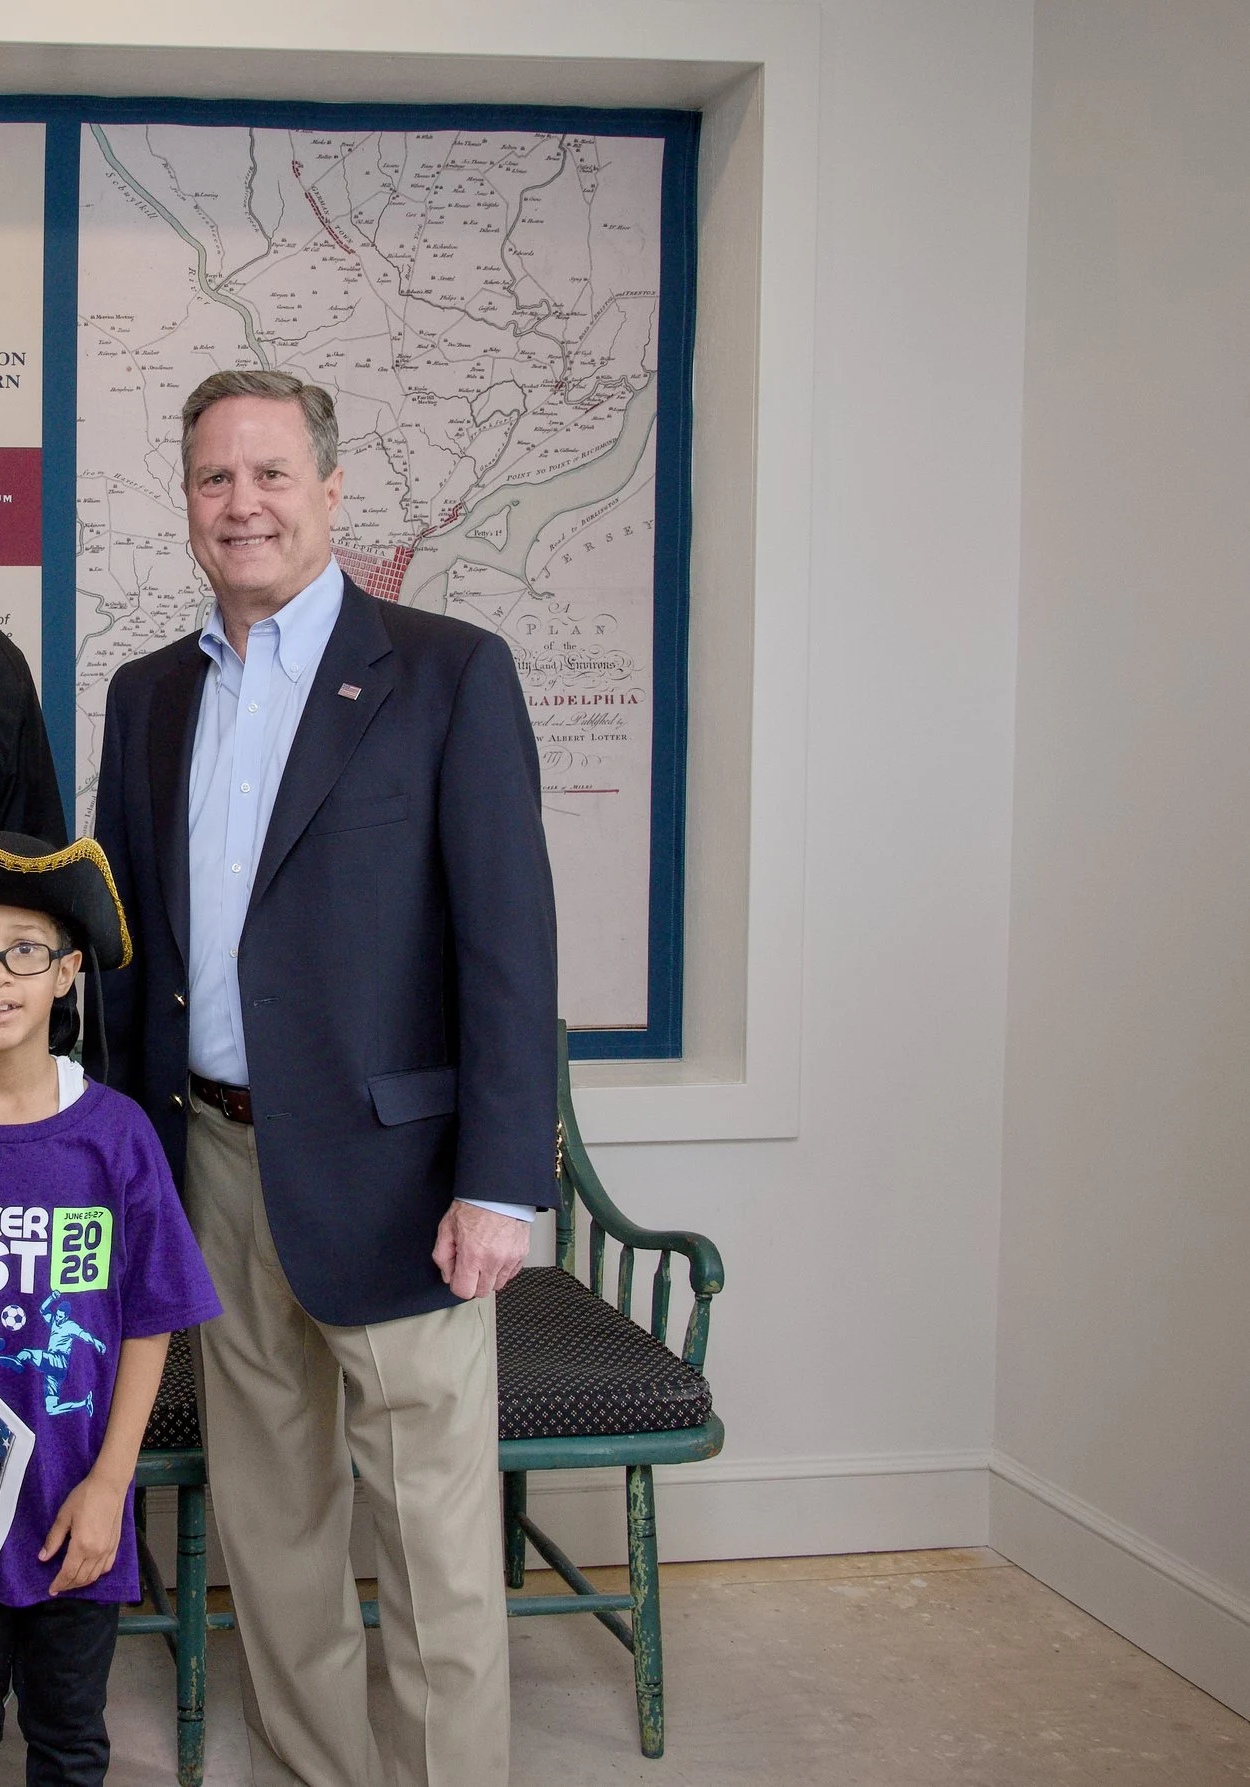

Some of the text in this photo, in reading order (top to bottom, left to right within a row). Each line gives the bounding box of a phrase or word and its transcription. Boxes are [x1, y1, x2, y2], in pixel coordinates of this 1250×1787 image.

[506, 471, 531, 481] POINT
[525, 623, 606, 636] PLAN
[543, 641, 577, 650] of the
[539, 661, 557, 670] and
[529, 694, 638, 706] LADELPHIA
[549, 733, 586, 742] ALBERT
[64, 1212, 83, 1220] JUNE
[62, 1220, 102, 1252] 20
[59, 1253, 99, 1285] 26
